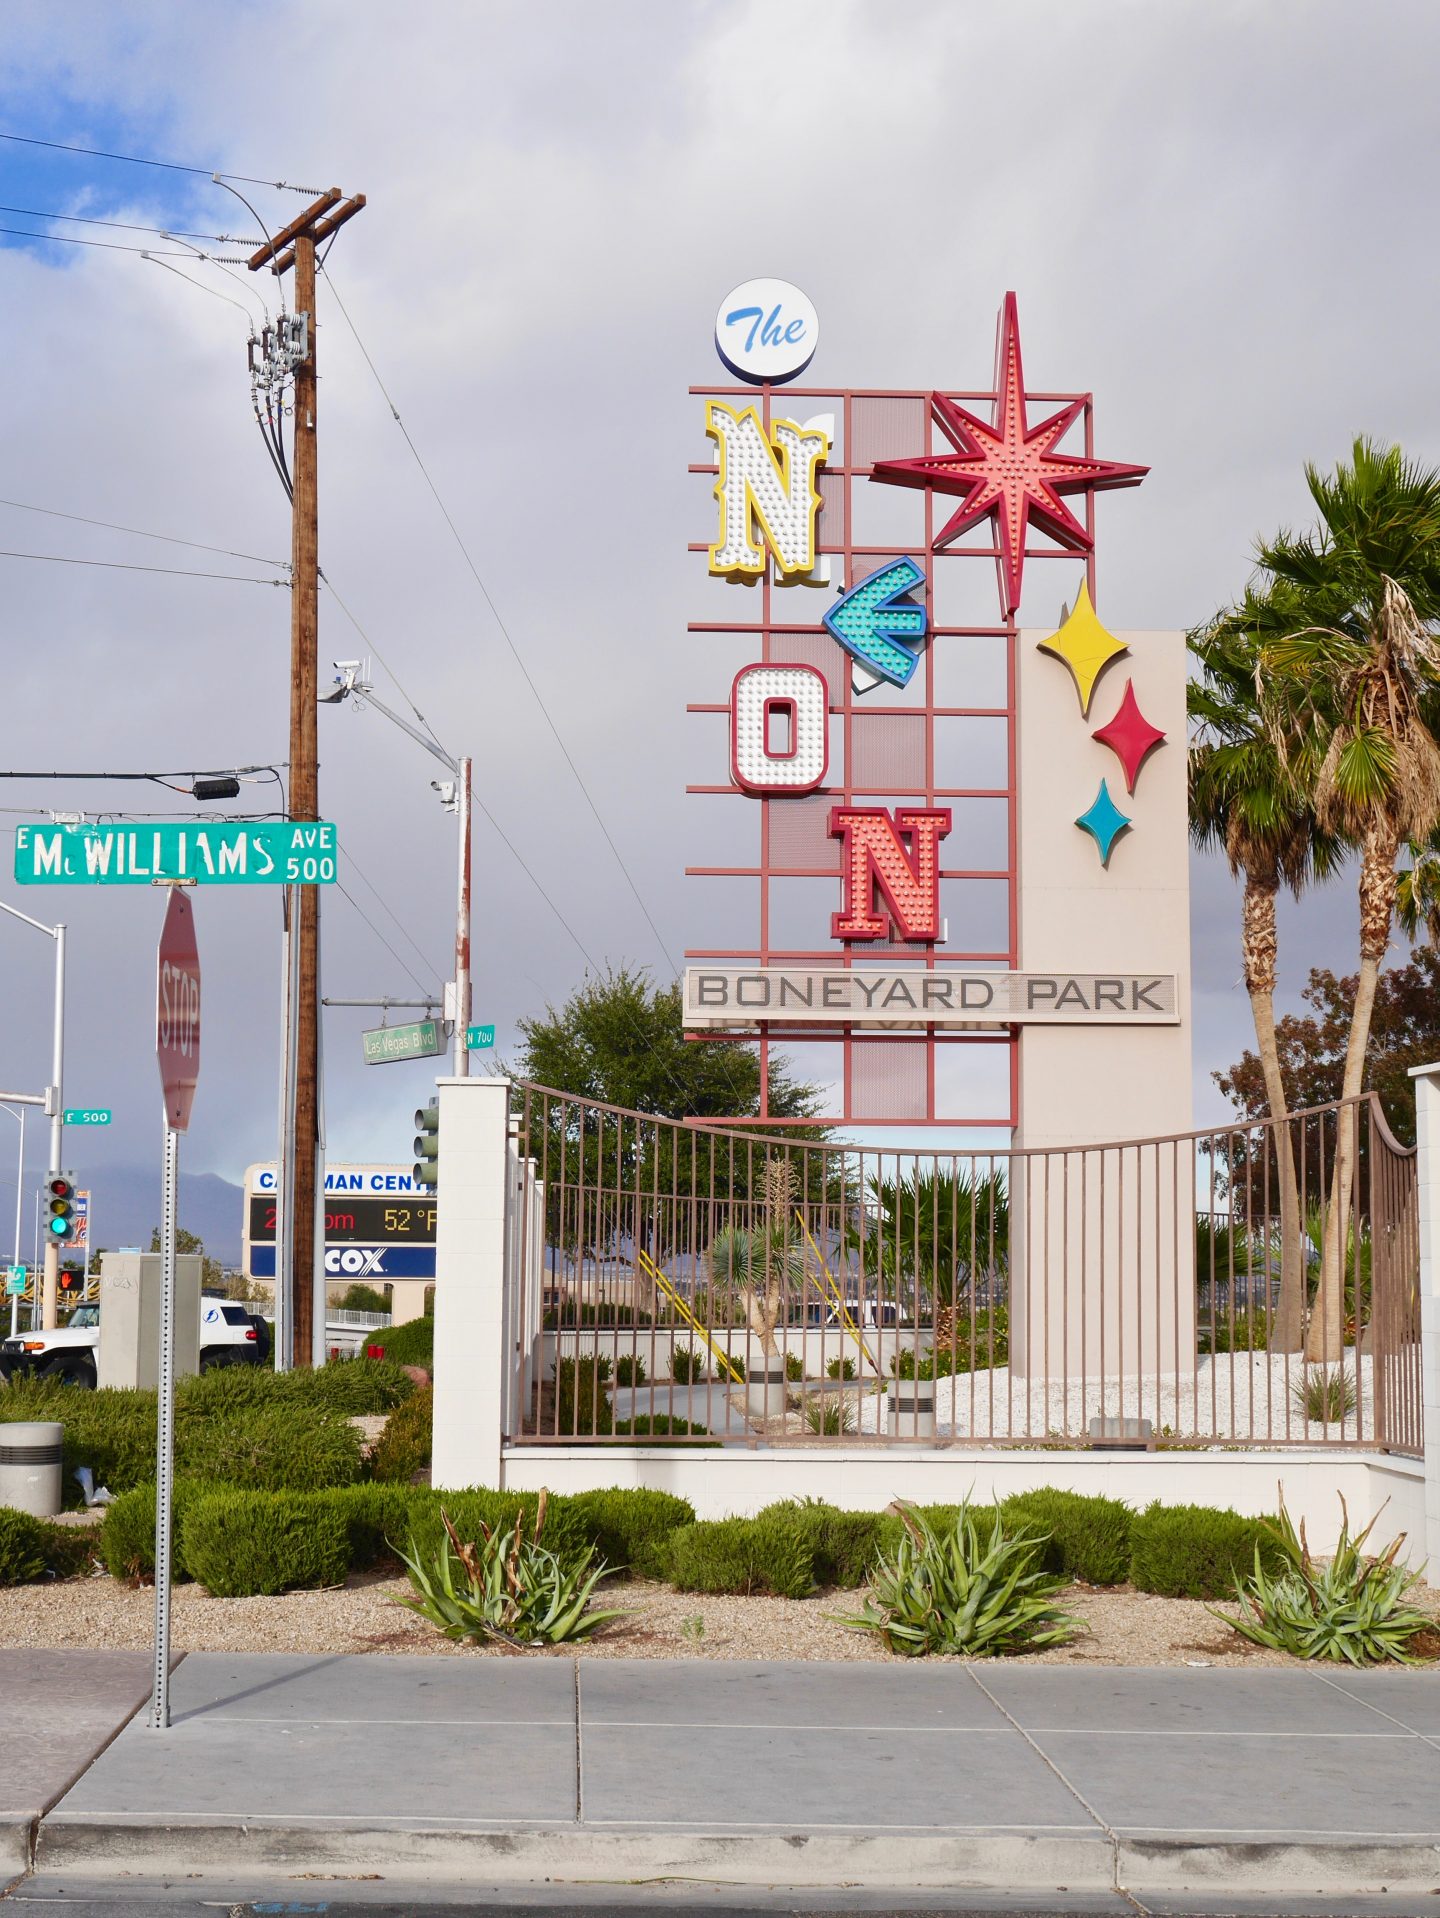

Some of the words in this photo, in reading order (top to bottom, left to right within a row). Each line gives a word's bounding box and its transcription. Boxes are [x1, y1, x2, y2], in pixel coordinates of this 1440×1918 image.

[725, 304, 807, 353] The
[17, 827, 30, 849] E
[290, 827, 333, 850] AVE
[286, 857, 334, 881] 500
[698, 974, 994, 1010] BONEYARD
[1027, 978, 1165, 1012] PARK
[161, 959, 198, 1059] STOP
[365, 1039, 381, 1055] Las
[382, 1035, 409, 1055] Vegas
[412, 1030, 434, 1048] Blvd
[477, 1030, 493, 1044] 700
[66, 1112, 74, 1122] E
[83, 1112, 108, 1122] 500
[384, 1209, 411, 1231] 52
[324, 1247, 388, 1277] COX
